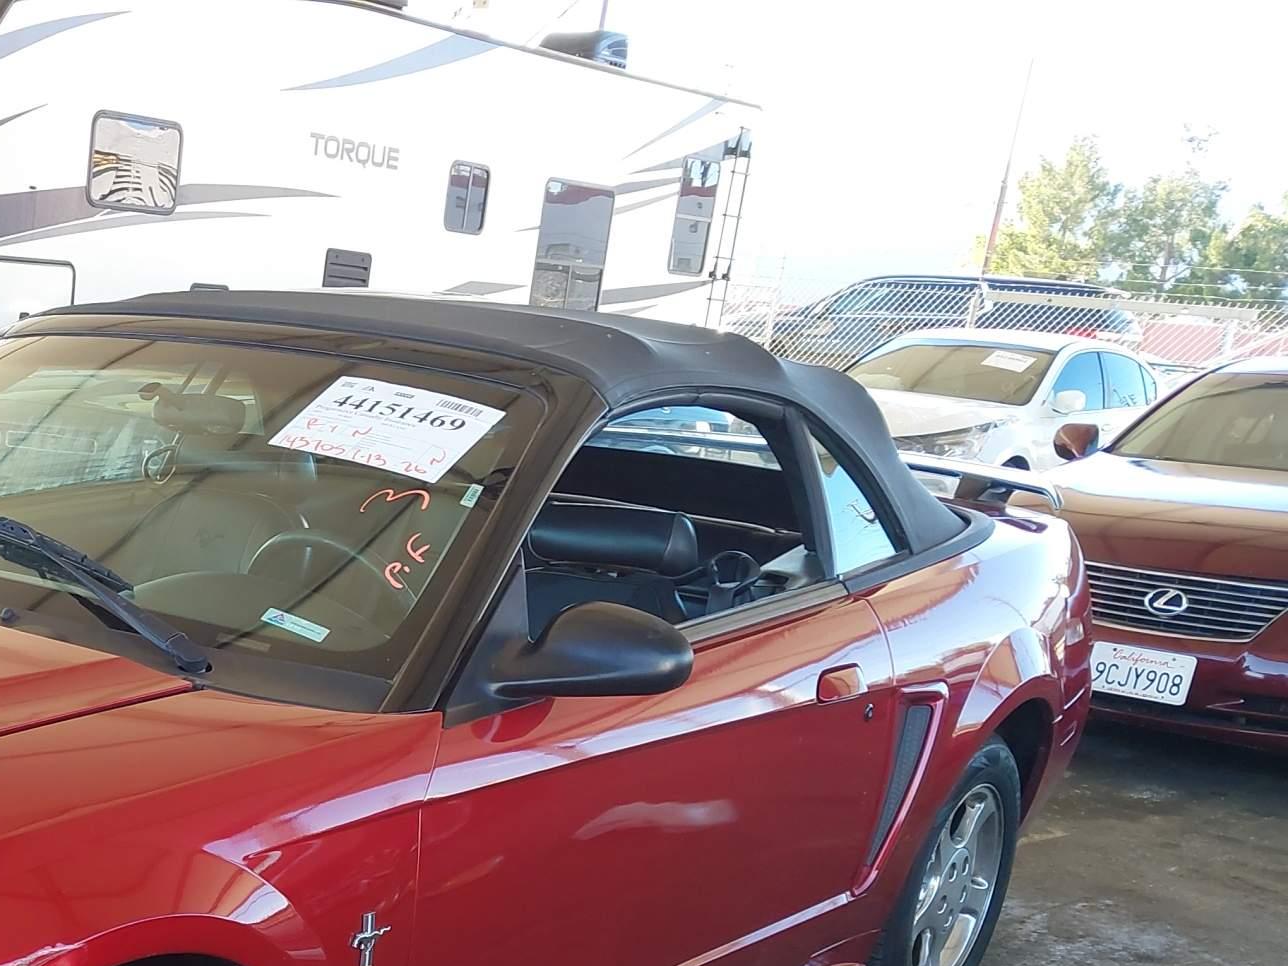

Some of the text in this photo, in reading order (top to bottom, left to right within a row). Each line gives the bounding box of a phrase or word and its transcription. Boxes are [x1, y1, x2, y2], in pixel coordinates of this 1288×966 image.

[310, 132, 400, 170] TORQUE
[333, 395, 466, 430] 44151469
[1113, 649, 1175, 668] California
[1093, 661, 1183, 696] 9CJY908
